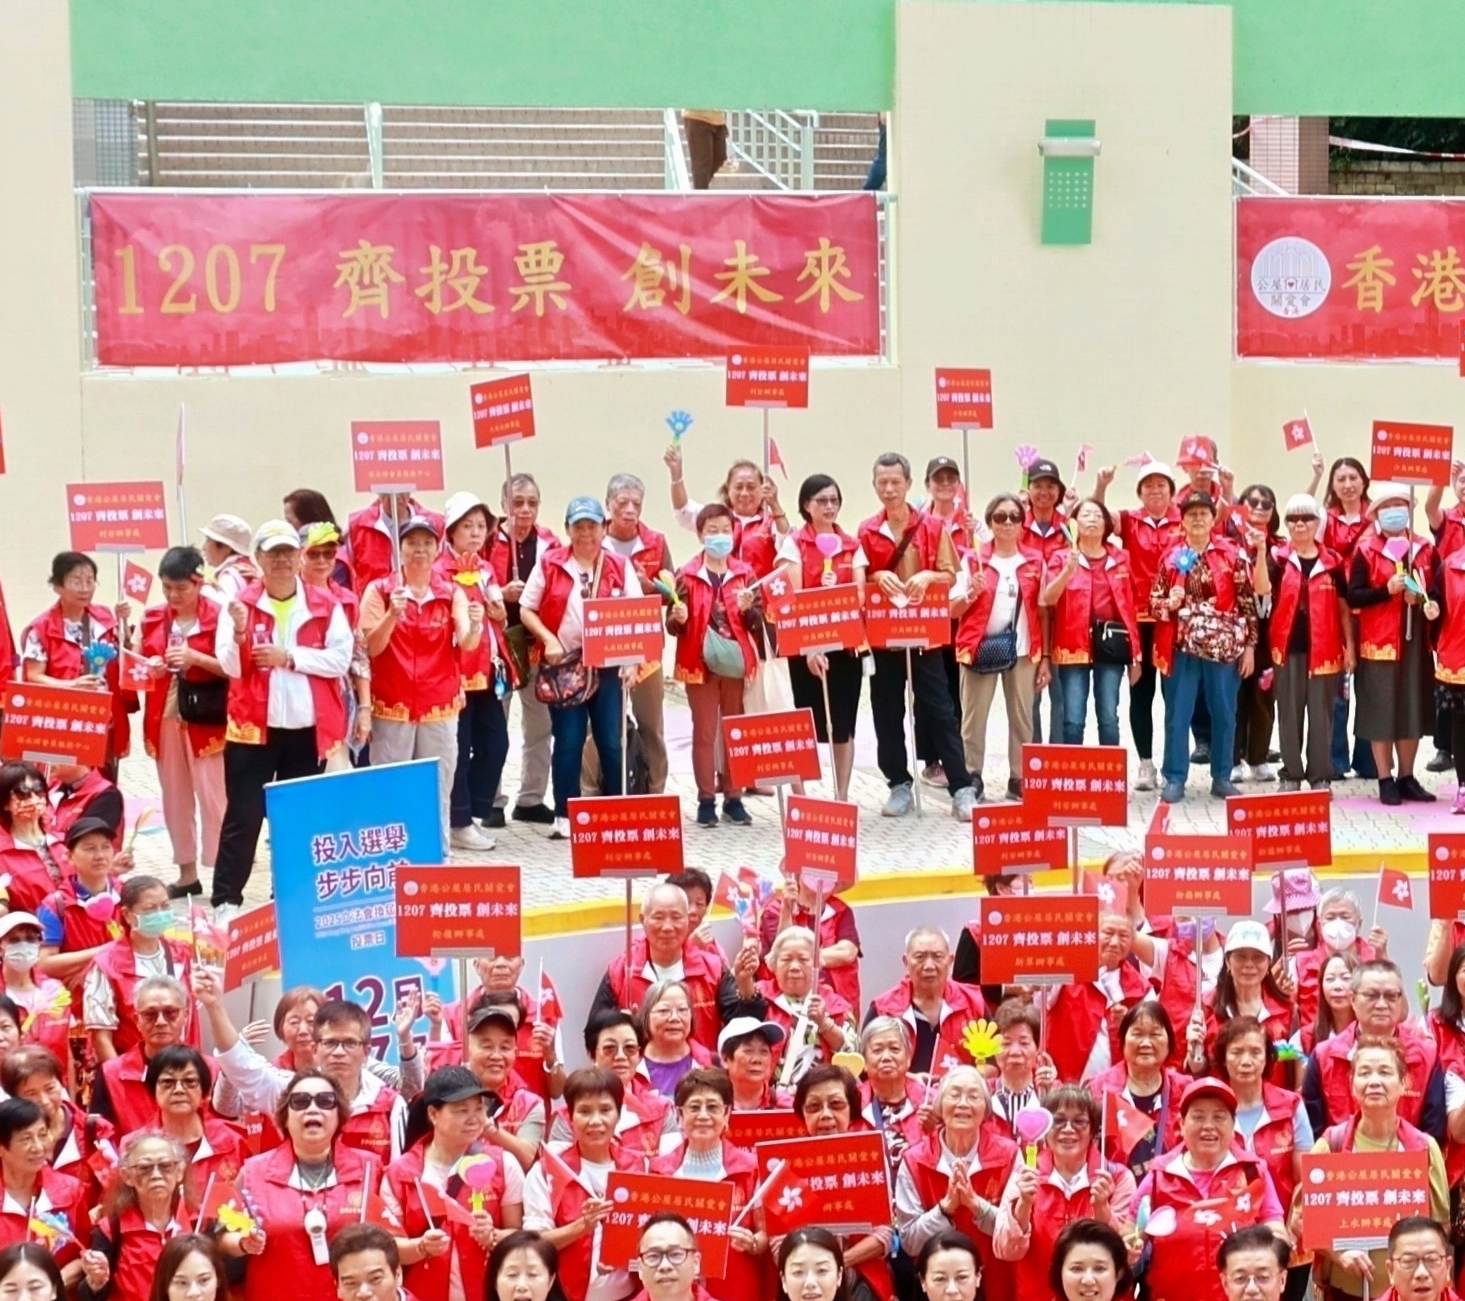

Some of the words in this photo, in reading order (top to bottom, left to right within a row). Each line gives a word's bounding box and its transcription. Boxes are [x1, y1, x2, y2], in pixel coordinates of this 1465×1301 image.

[116, 243, 286, 314] 1207
[335, 240, 567, 319] 齊投票
[623, 238, 864, 314] 創未來
[572, 832, 597, 843] 1207
[601, 829, 638, 842] 齊投票
[642, 827, 679, 841] 創未來
[313, 824, 406, 864] 投入選舉
[1146, 867, 1170, 878] 1207
[1174, 867, 1209, 880] 齊投票
[1213, 867, 1249, 880] 創未來
[1429, 869, 1455, 880] 1207
[397, 904, 425, 916] 1207
[430, 902, 471, 917] 齊投票
[476, 902, 517, 916] 創未來
[351, 931, 385, 949] 投票日
[1326, 1168, 1422, 1180] 香港公屋居民關愛會
[1304, 1192, 1331, 1205] 1207
[1336, 1190, 1378, 1205] 齊投票
[1383, 1189, 1425, 1204] 創未來
